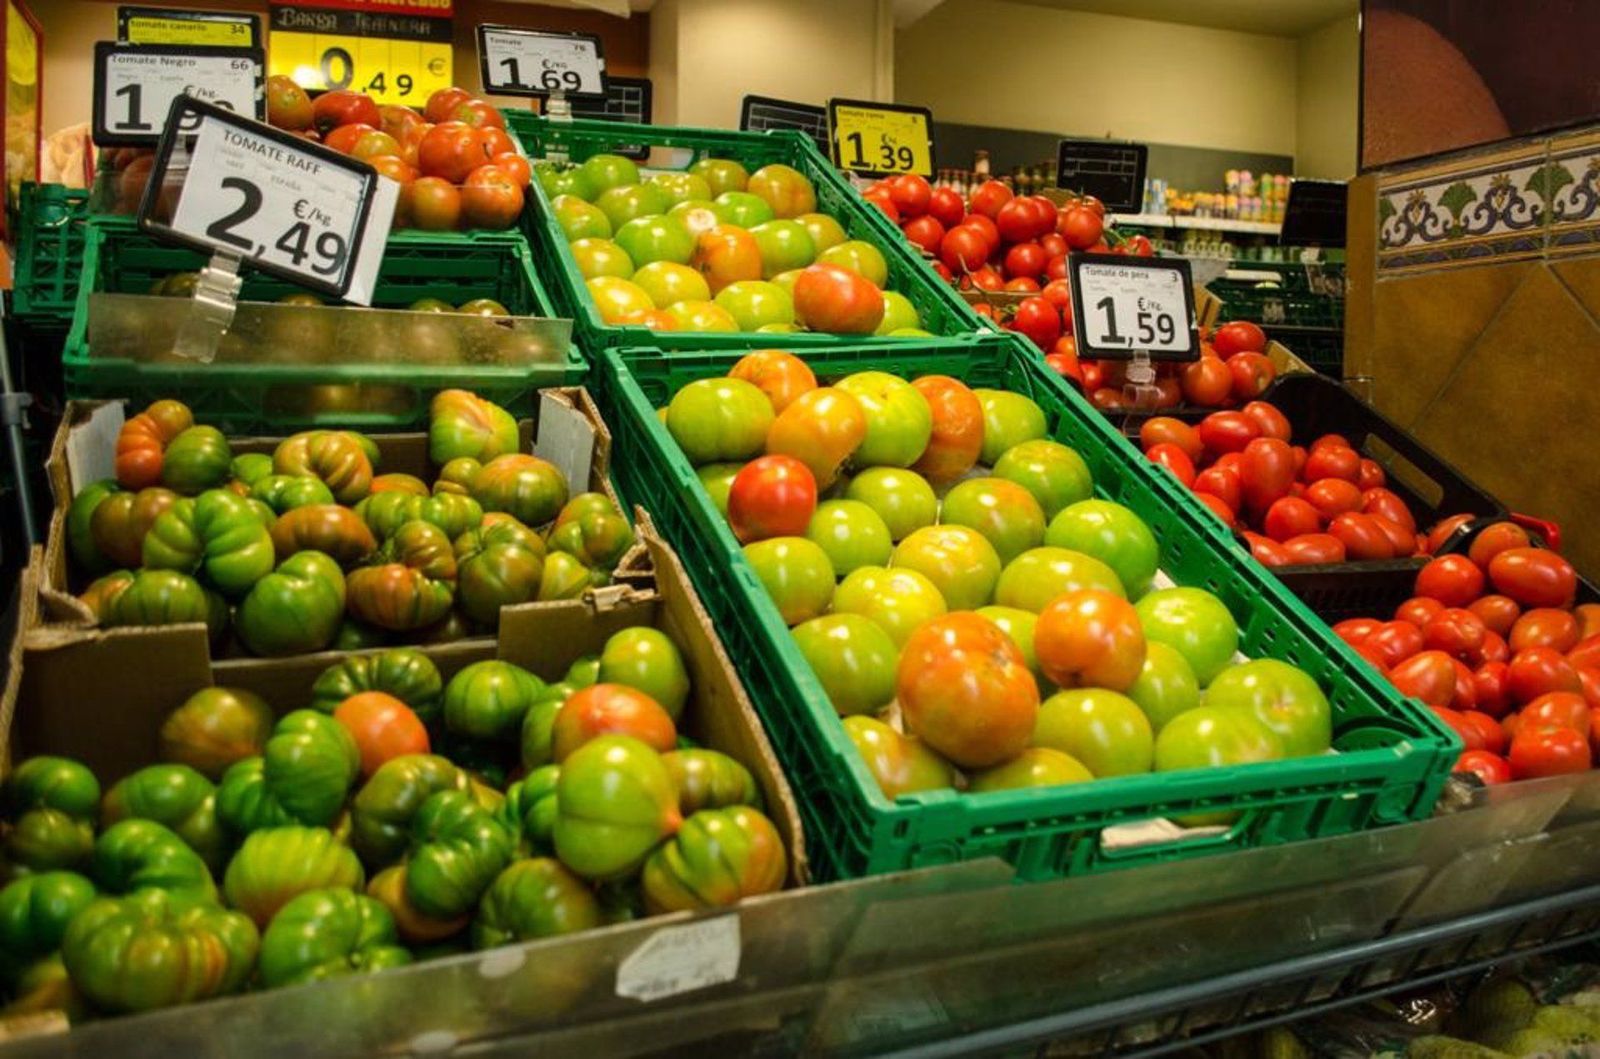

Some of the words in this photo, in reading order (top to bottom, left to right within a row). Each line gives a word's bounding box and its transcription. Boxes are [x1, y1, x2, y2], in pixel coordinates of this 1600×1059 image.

[230, 24, 245, 35] 34
[112, 54, 157, 65] Tomate
[160, 56, 197, 67] Negro
[230, 60, 249, 71] 66
[223, 129, 284, 162] TOMATE
[286, 152, 323, 176] RAFF
[847, 131, 914, 171] 1,39
[206, 176, 347, 276] 2,49
[1171, 271, 1178, 282] 3
[1096, 296, 1176, 348] 1,59
